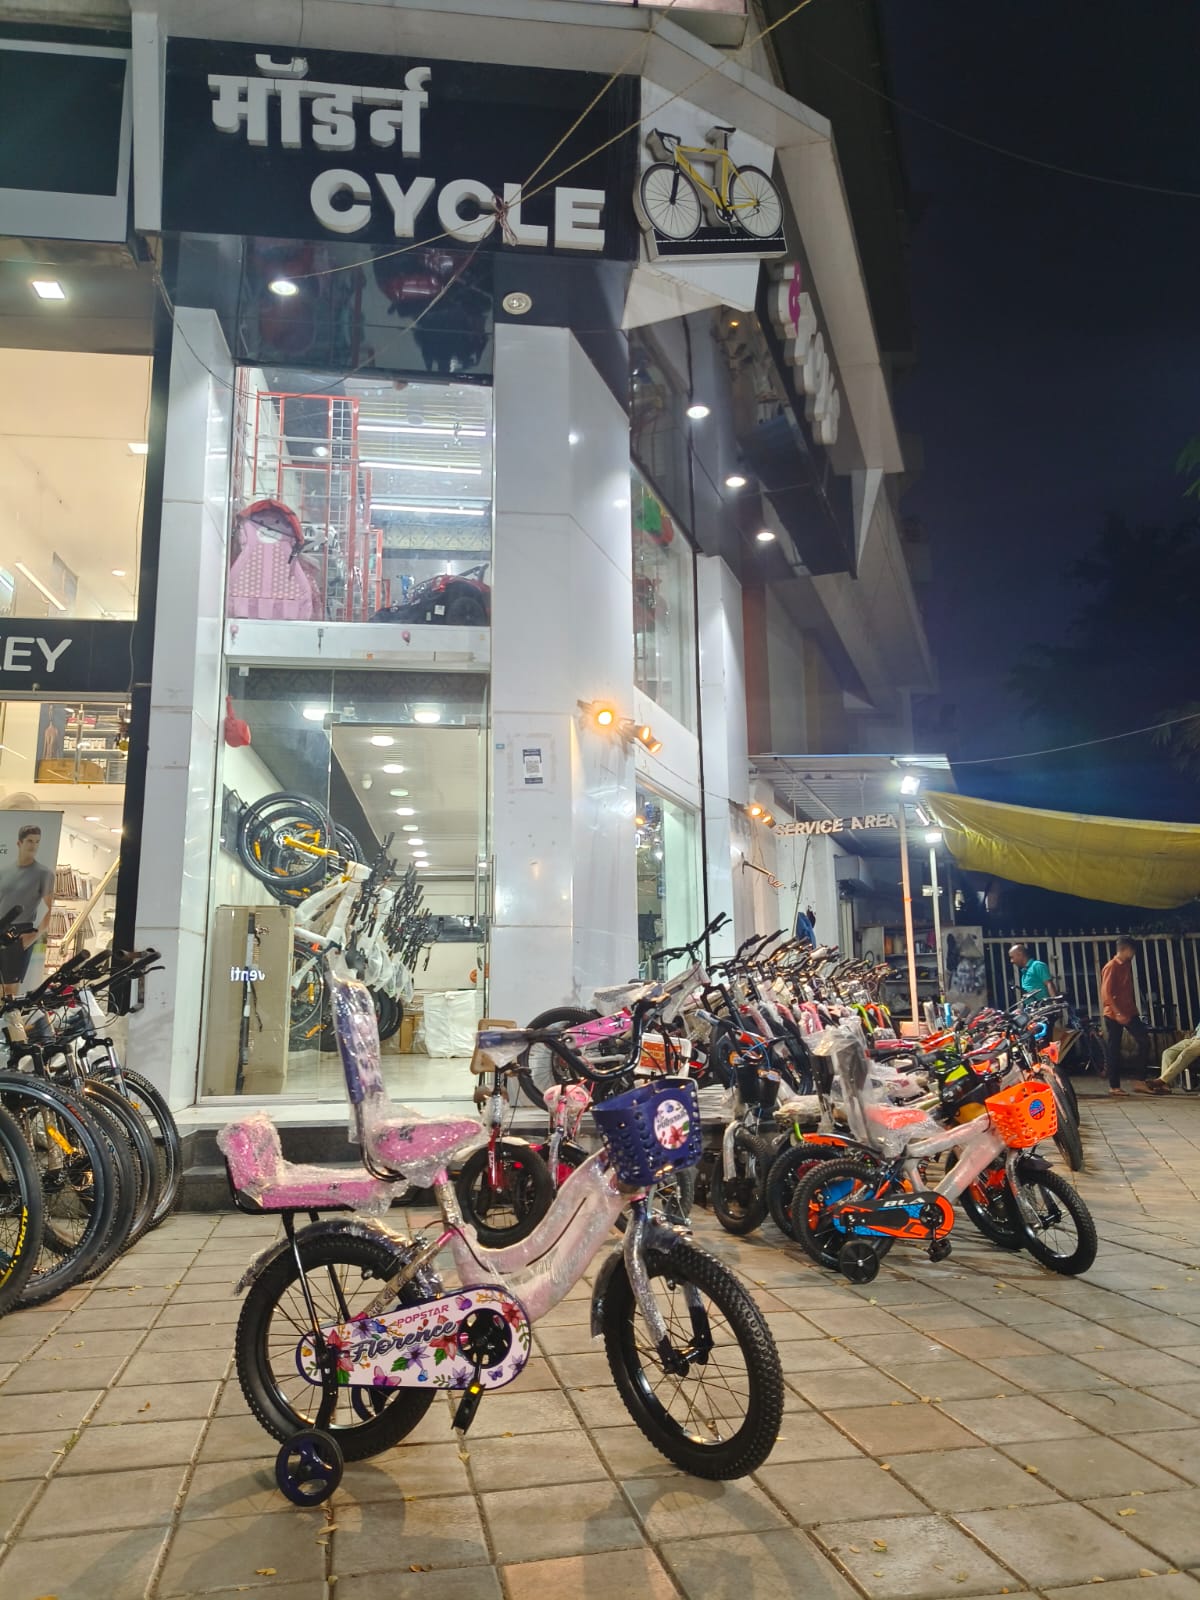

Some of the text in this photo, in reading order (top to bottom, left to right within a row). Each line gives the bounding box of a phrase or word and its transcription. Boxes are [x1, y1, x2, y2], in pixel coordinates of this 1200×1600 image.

[207, 53, 432, 158] मॉडर्न
[310, 168, 606, 251] CYCLE
[0, 636, 73, 673] EY
[773, 813, 898, 837] SERVICE AREA
[396, 1304, 450, 1328] POPSTAR
[350, 1320, 457, 1363] Florence
